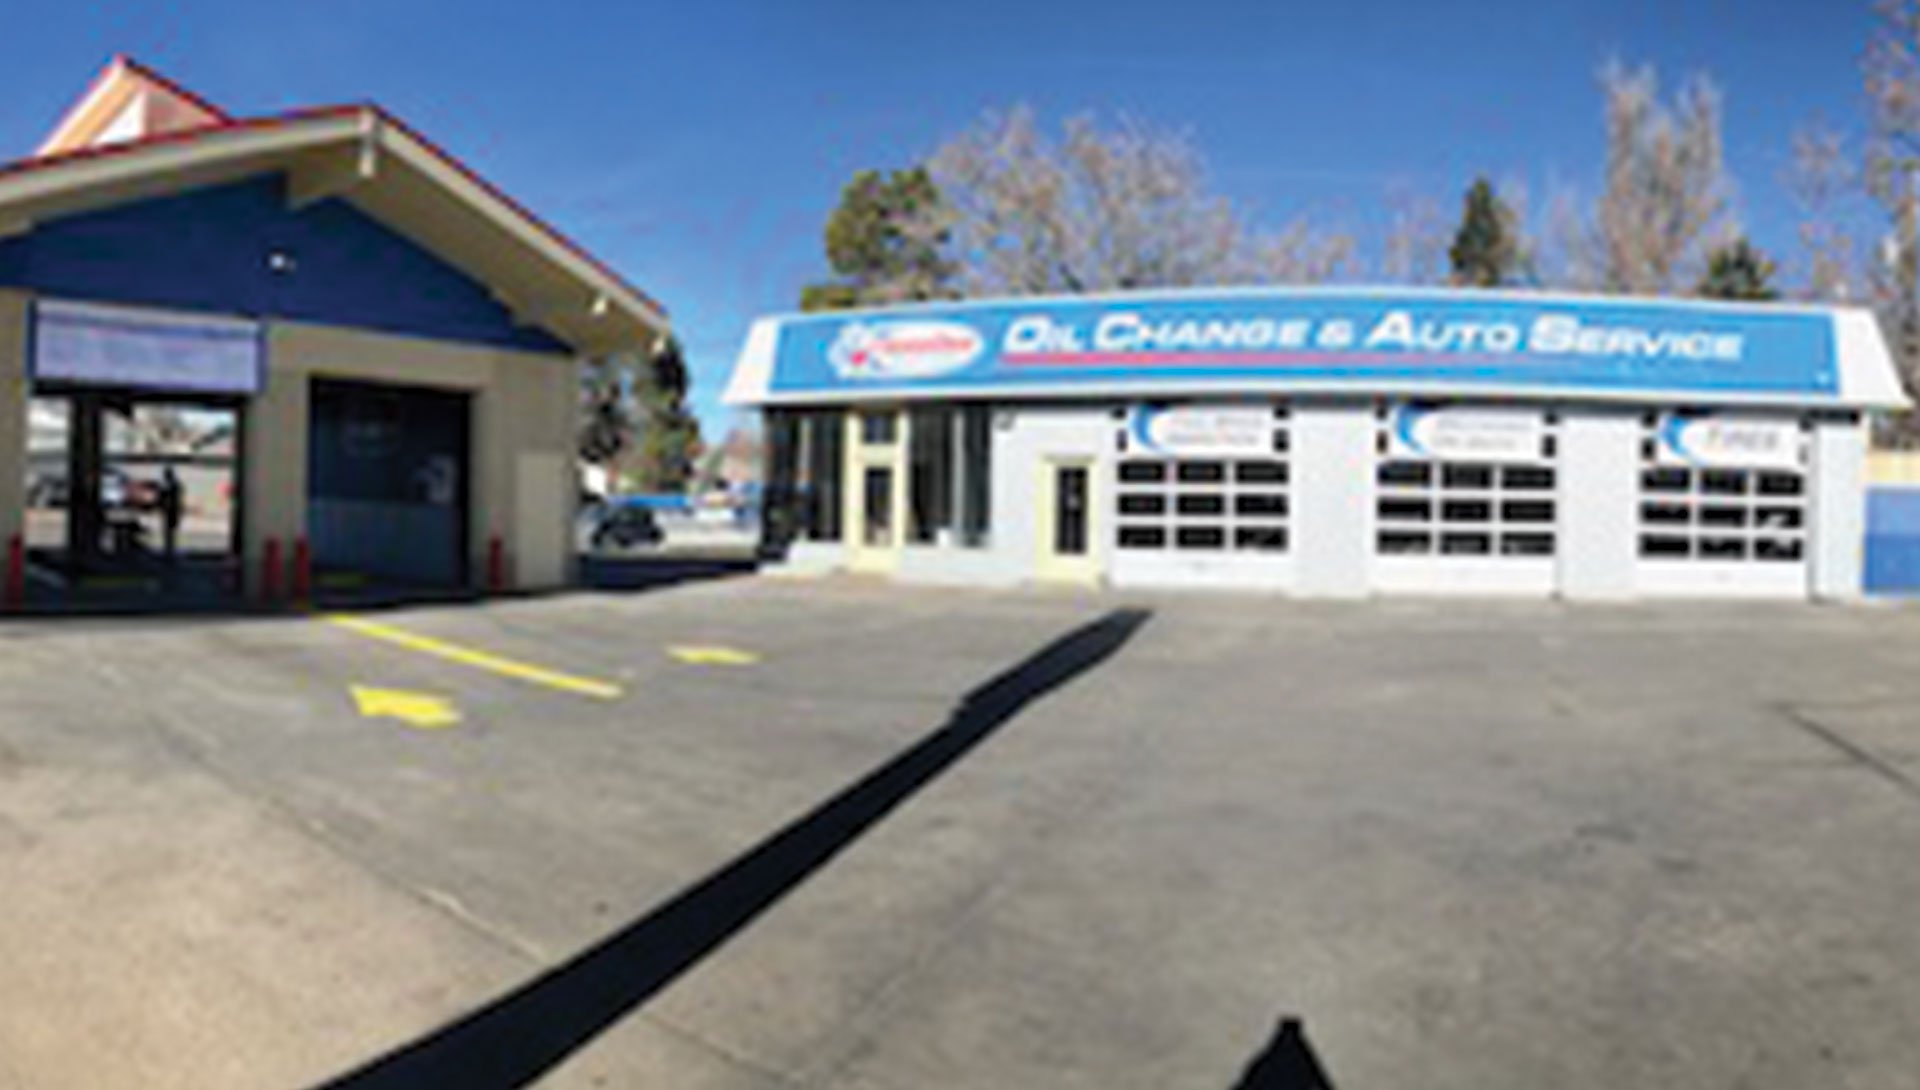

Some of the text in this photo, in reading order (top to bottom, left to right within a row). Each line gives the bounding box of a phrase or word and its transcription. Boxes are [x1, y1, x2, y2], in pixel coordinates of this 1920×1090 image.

[1094, 312, 1310, 352] CHANGE
[1316, 319, 1354, 347] &
[1366, 311, 1520, 350] AUTO
[1529, 313, 1744, 359] SERVICE
